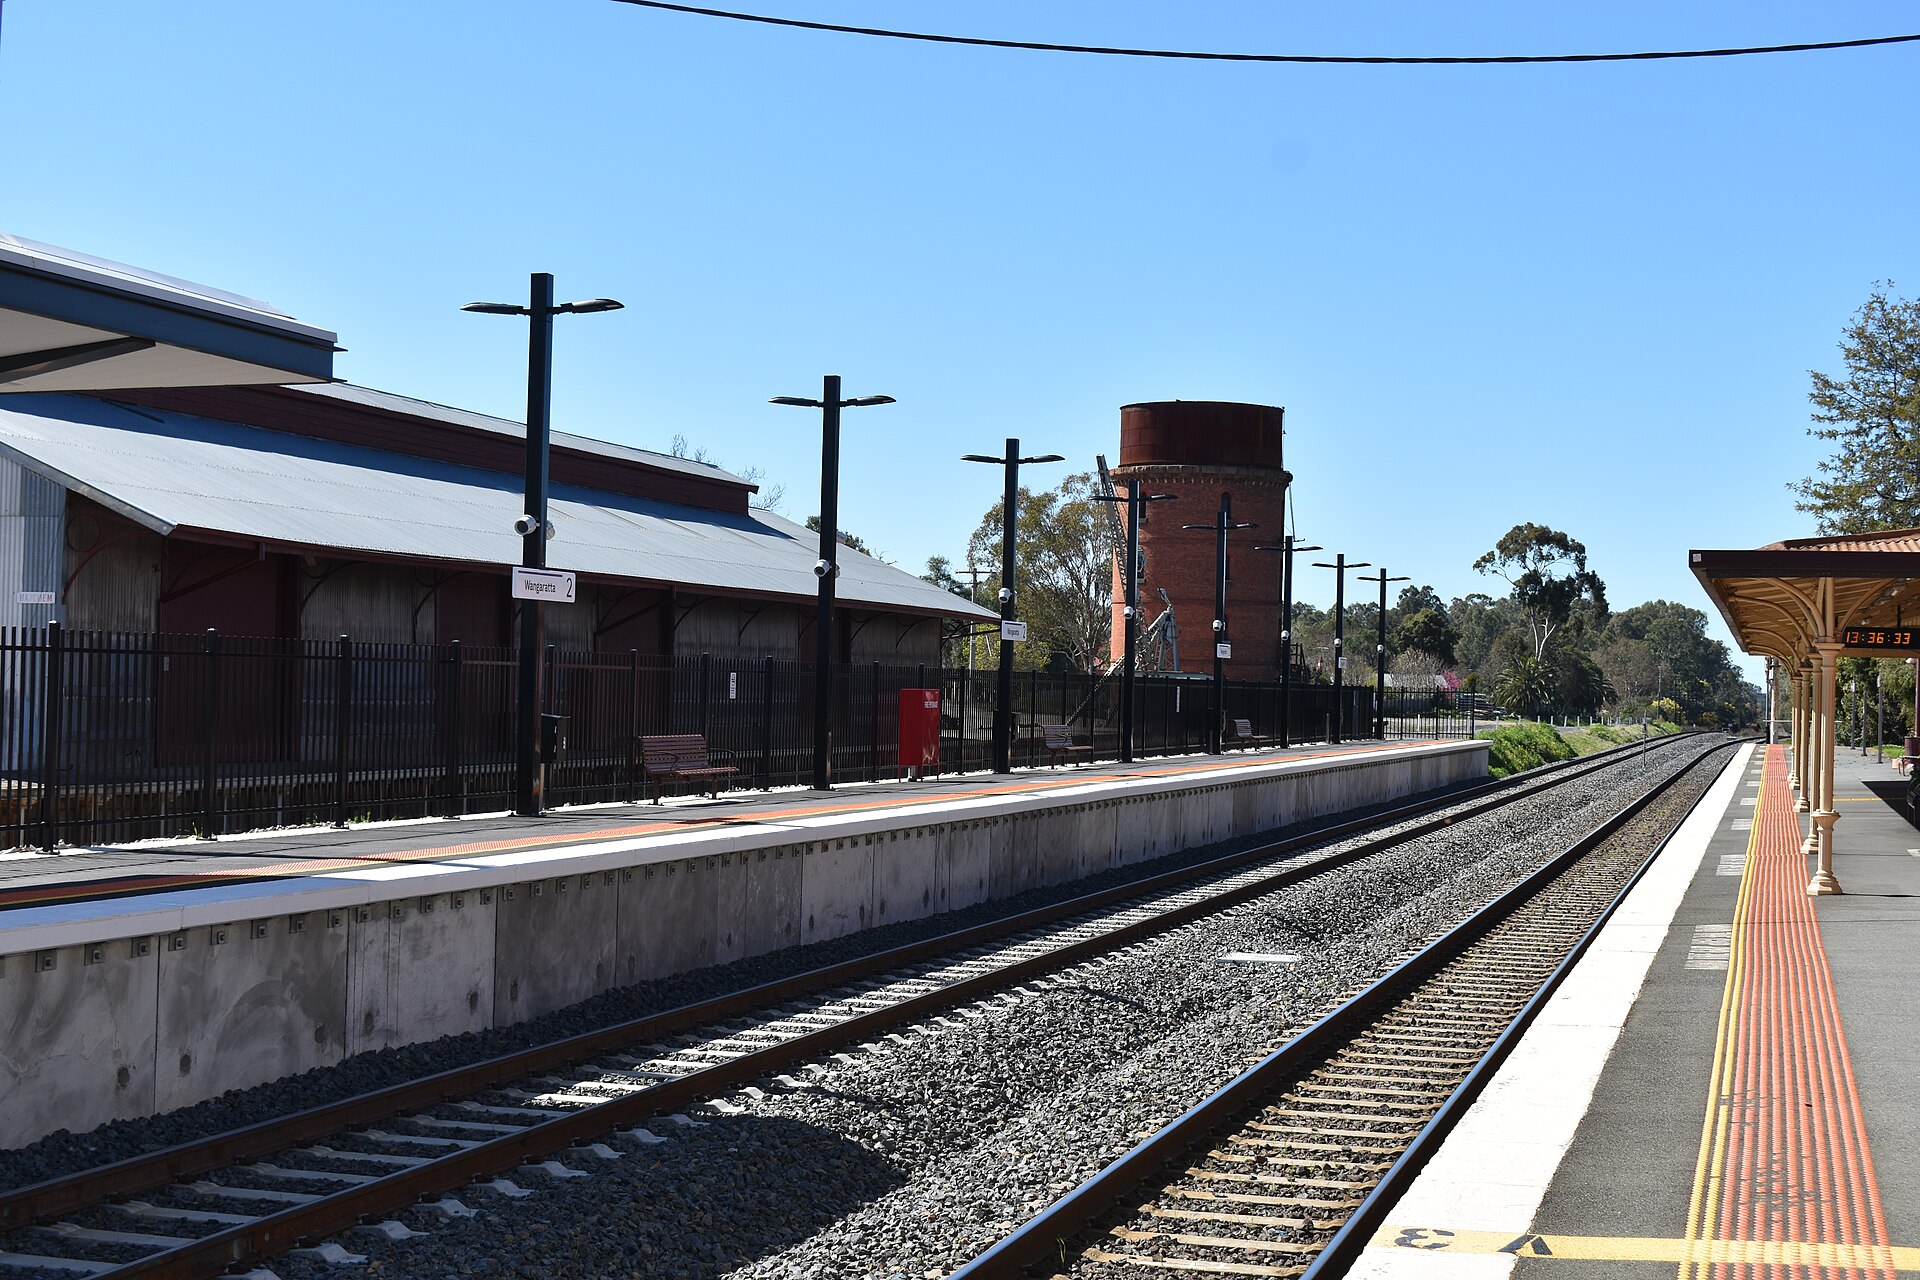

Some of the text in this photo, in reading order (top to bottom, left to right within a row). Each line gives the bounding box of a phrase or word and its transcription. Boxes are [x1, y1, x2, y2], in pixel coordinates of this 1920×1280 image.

[524, 577, 573, 598] Wangaratta 2
[1846, 631, 1911, 645] 13:36:33
